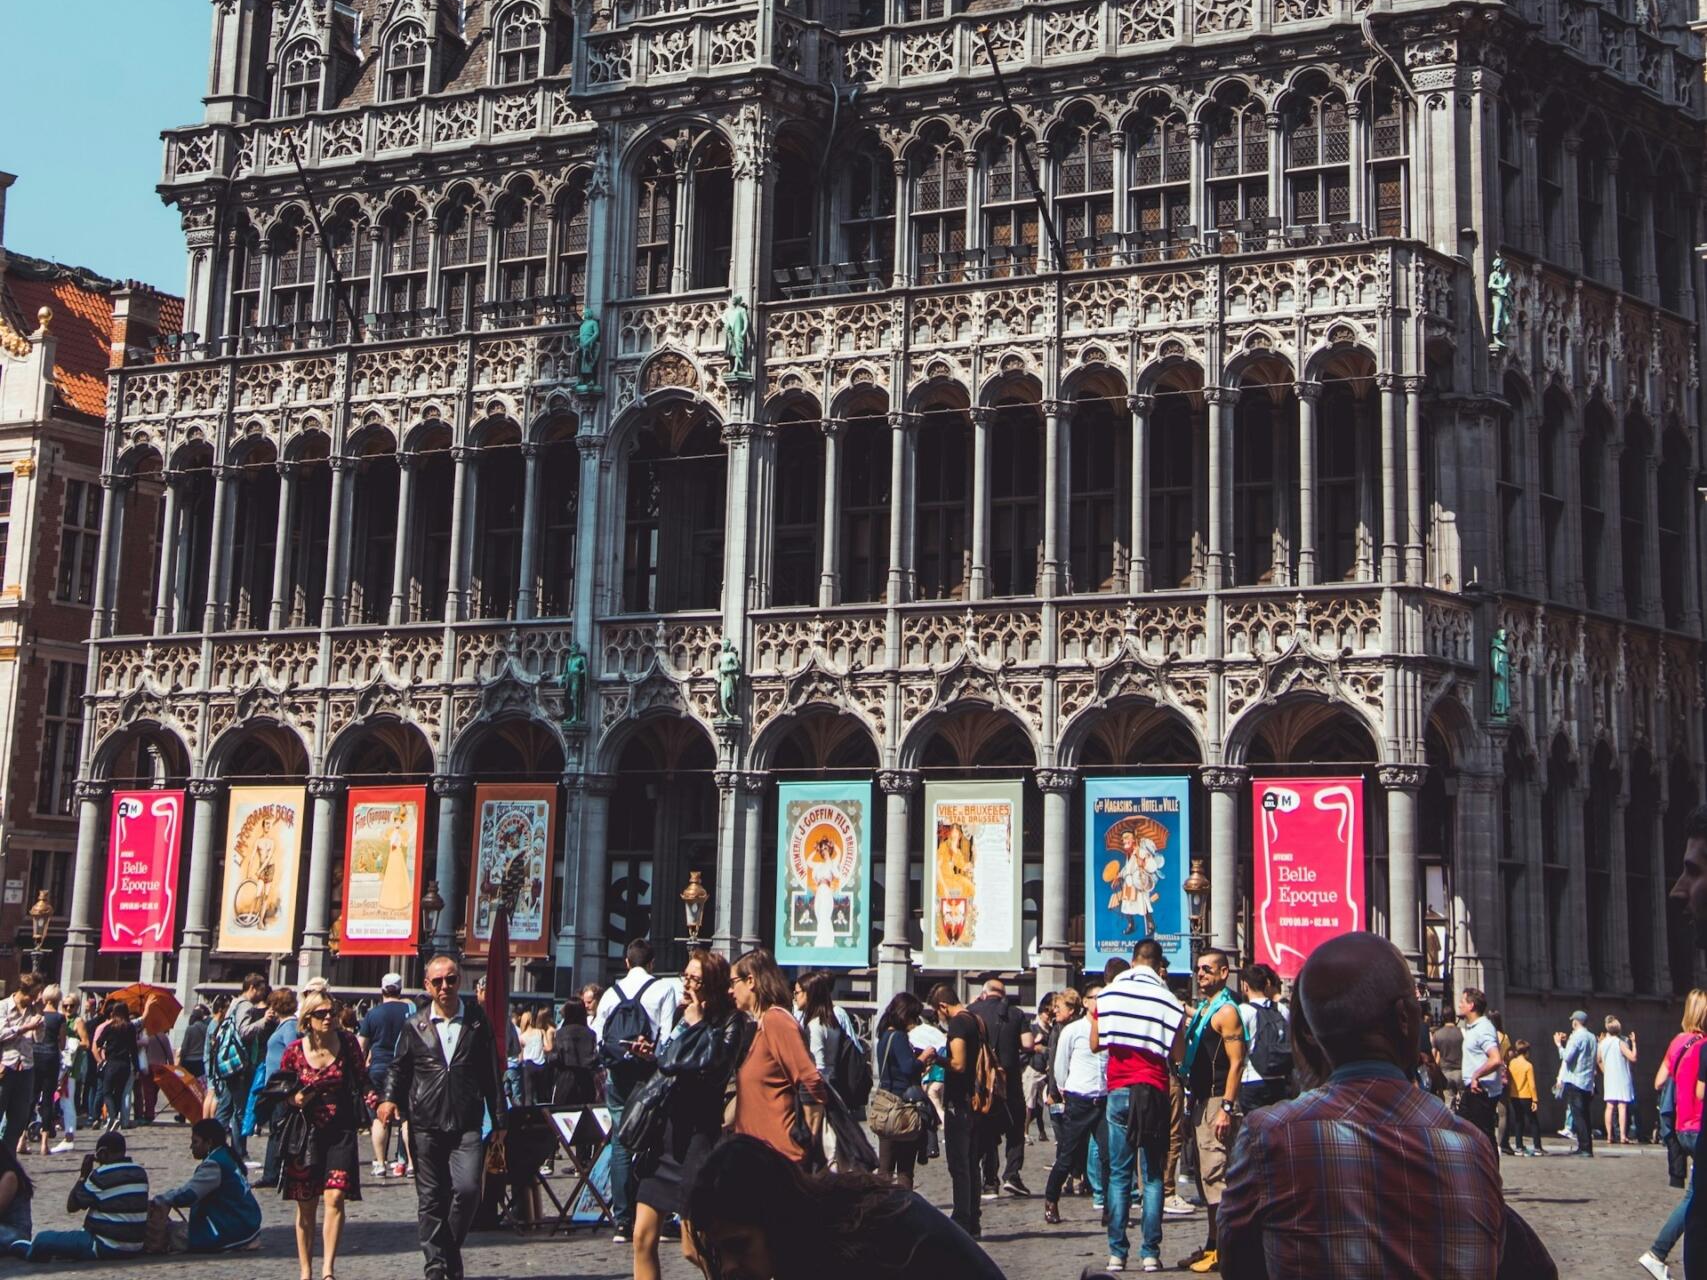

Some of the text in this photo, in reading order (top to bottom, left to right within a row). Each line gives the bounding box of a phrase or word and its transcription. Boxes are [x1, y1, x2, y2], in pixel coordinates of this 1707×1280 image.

[1104, 798, 1133, 813] MAGASINS
[1163, 797, 1179, 812] VILLE
[1281, 795, 1291, 806] M
[804, 808, 834, 827] GOFFIN
[834, 812, 850, 834] FILS
[122, 861, 148, 874] Belle
[1278, 865, 1317, 882] Belle
[121, 876, 160, 894] Époque
[1278, 883, 1338, 907] Époque
